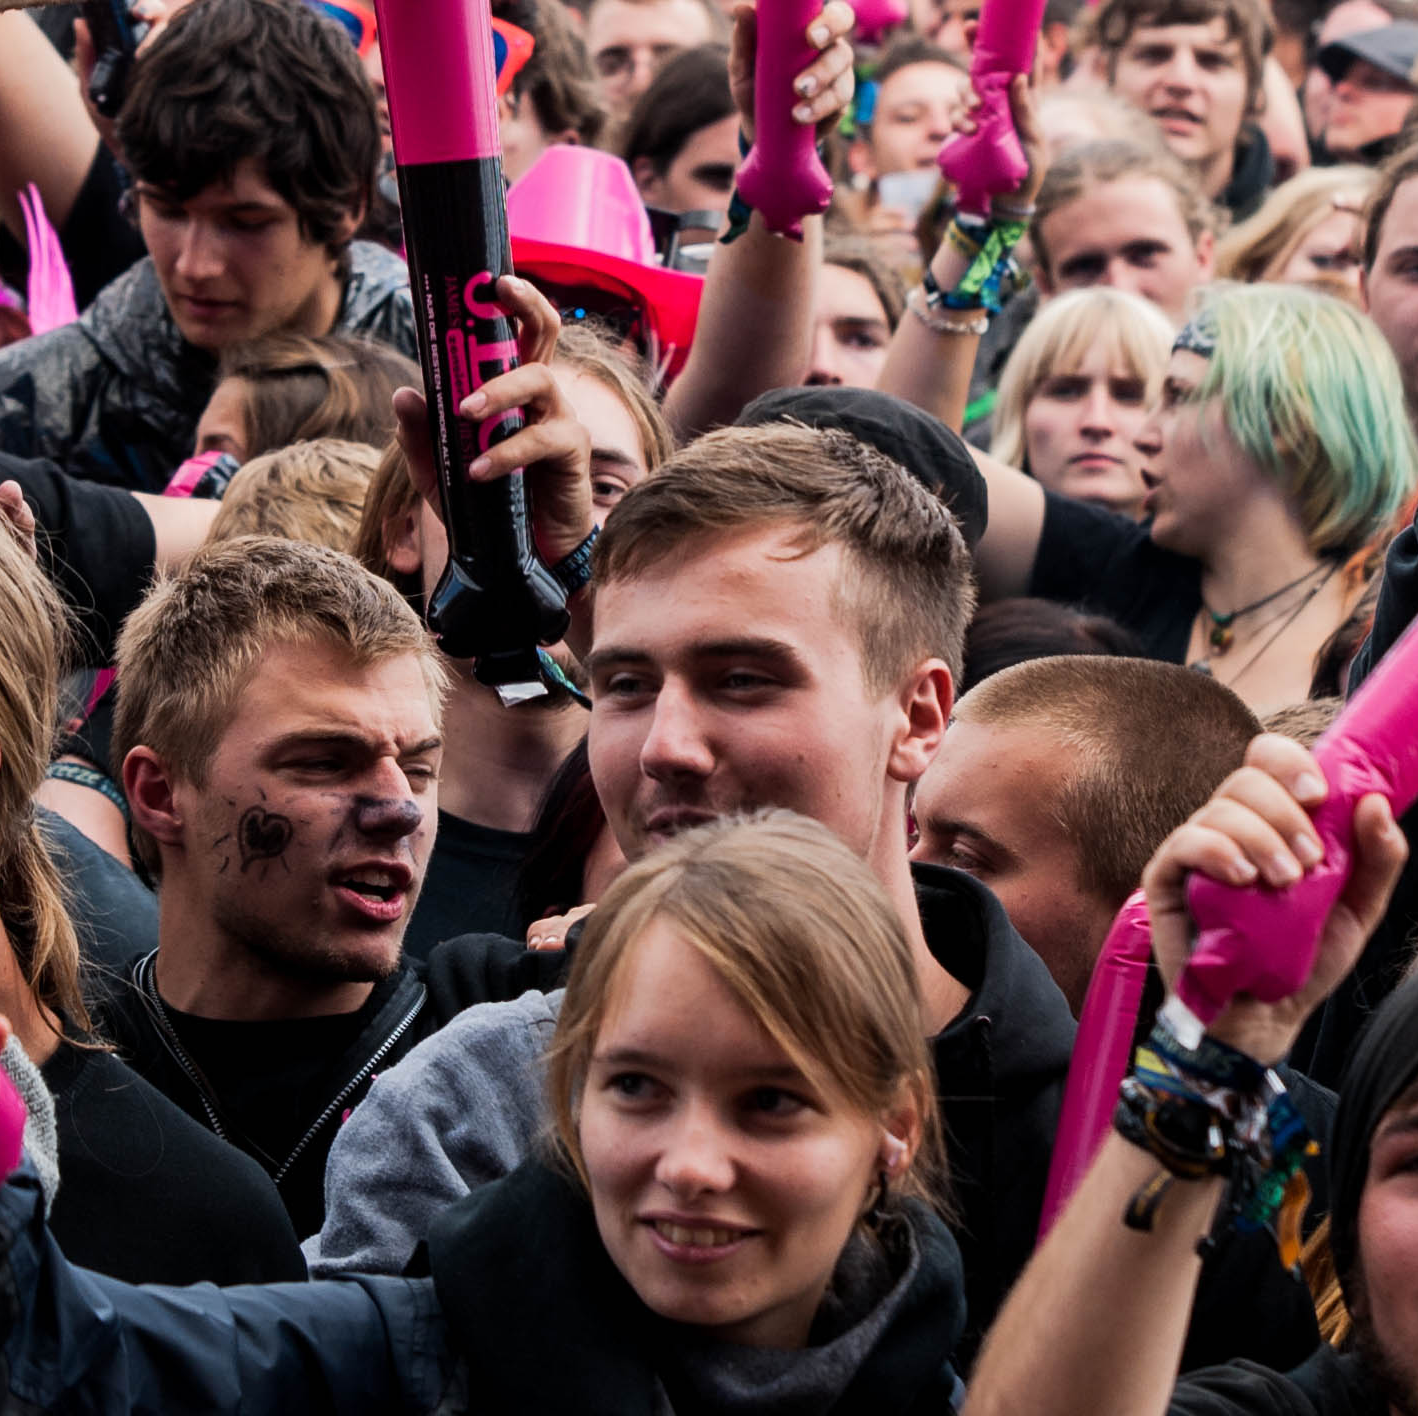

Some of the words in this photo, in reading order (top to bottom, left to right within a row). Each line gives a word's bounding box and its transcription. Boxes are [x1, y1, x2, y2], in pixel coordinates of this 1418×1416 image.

[426, 293, 436, 320] NUR
[428, 320, 438, 342] DIE
[430, 343, 442, 391] BESTEN
[436, 392, 448, 441] WERDEN
